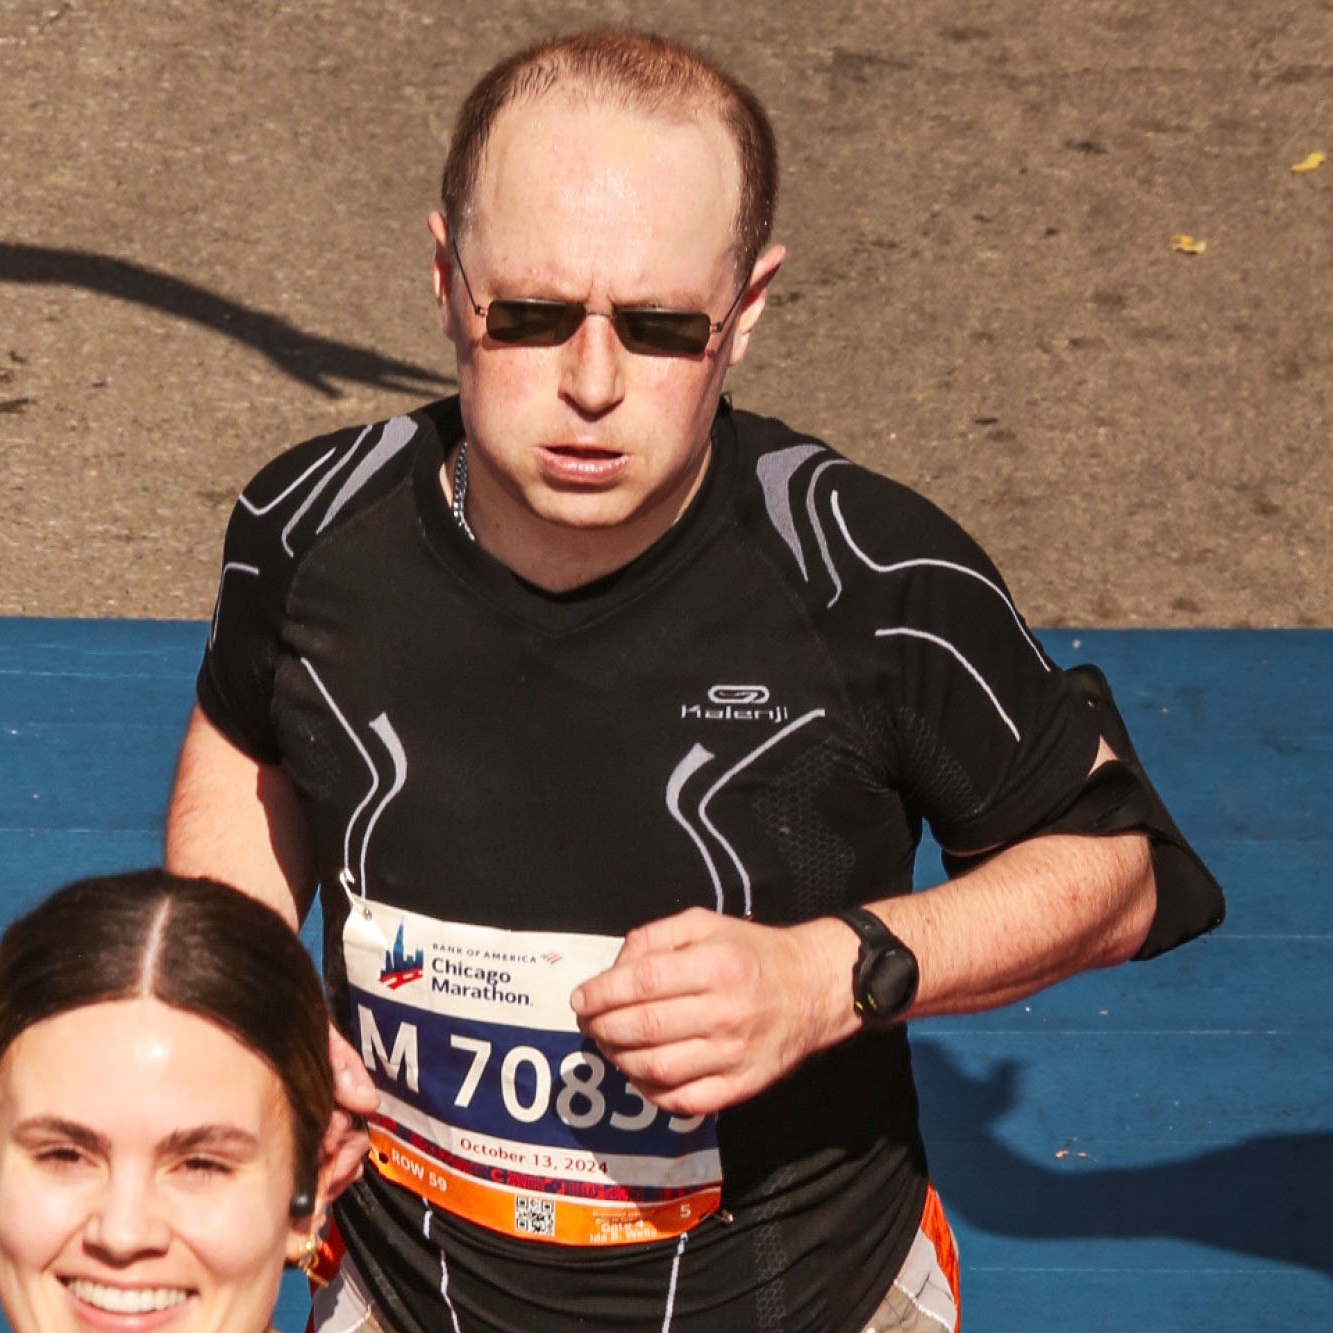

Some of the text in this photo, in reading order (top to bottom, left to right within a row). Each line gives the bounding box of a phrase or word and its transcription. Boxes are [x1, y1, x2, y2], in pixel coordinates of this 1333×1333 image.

[432, 943, 537, 964] BANK OF AMERICA
[431, 957, 512, 986] Chicago
[431, 976, 531, 1006] Marathon
[358, 1003, 705, 1134] M 7083
[390, 1149, 448, 1193] ROW 59
[459, 1137, 609, 1175] October 13, 2024
[680, 1203, 692, 1219] 5
